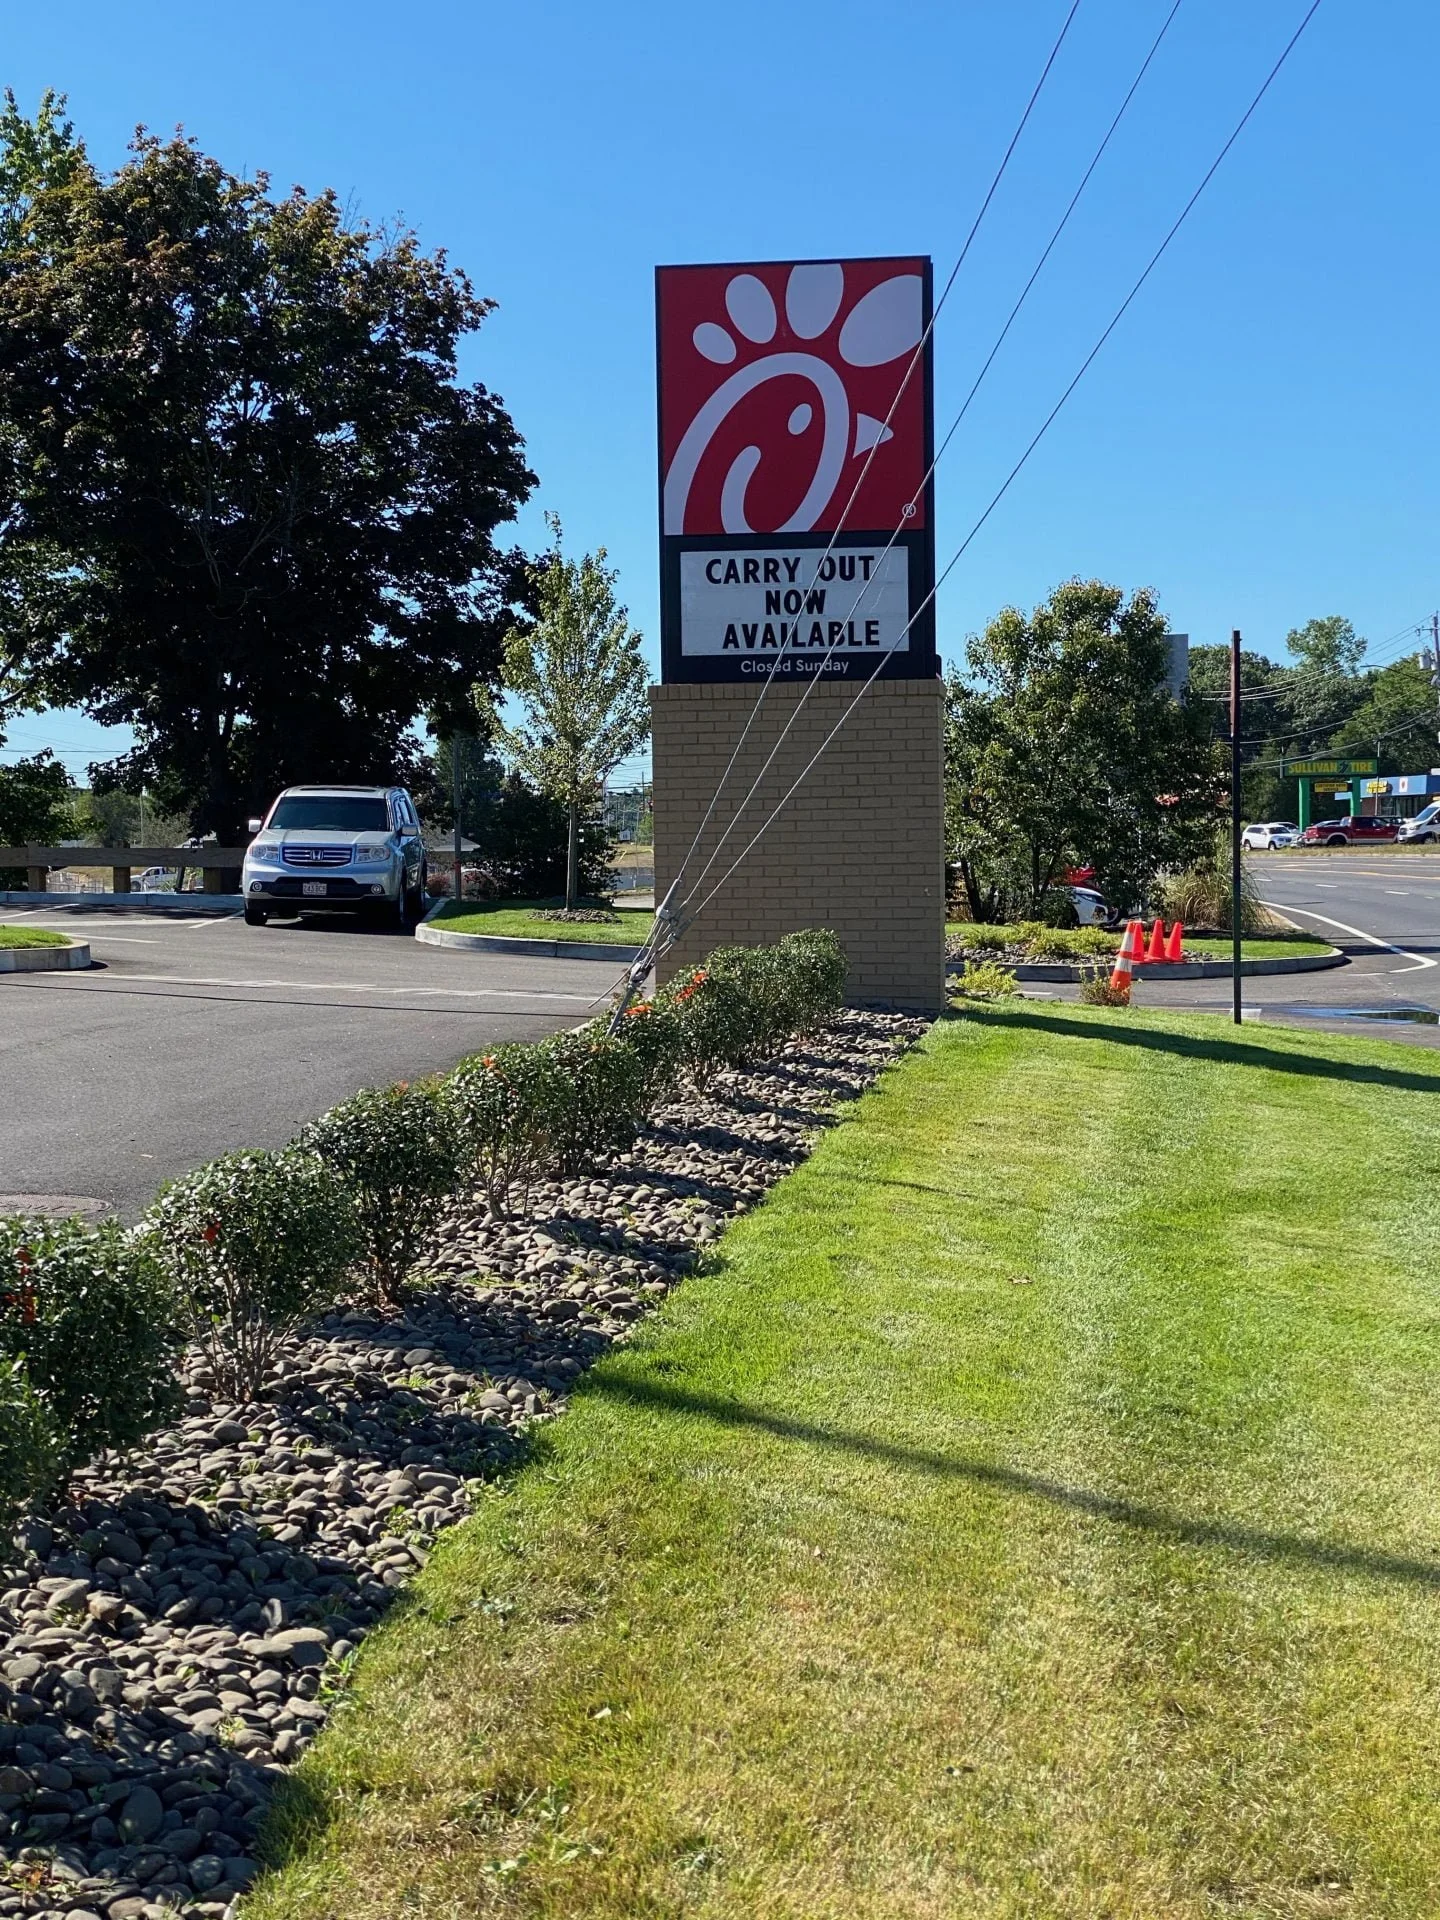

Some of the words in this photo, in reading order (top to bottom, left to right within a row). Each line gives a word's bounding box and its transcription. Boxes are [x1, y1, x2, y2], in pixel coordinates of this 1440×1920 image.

[705, 557, 801, 584] CARRY
[817, 555, 875, 581] OUT
[765, 589, 827, 615] NOW
[722, 620, 880, 649] AVAILABLE
[740, 659, 791, 673] Closed
[795, 659, 849, 674] Sunday
[1288, 761, 1338, 774] SULLIVAN
[1350, 761, 1373, 773] TIRE
